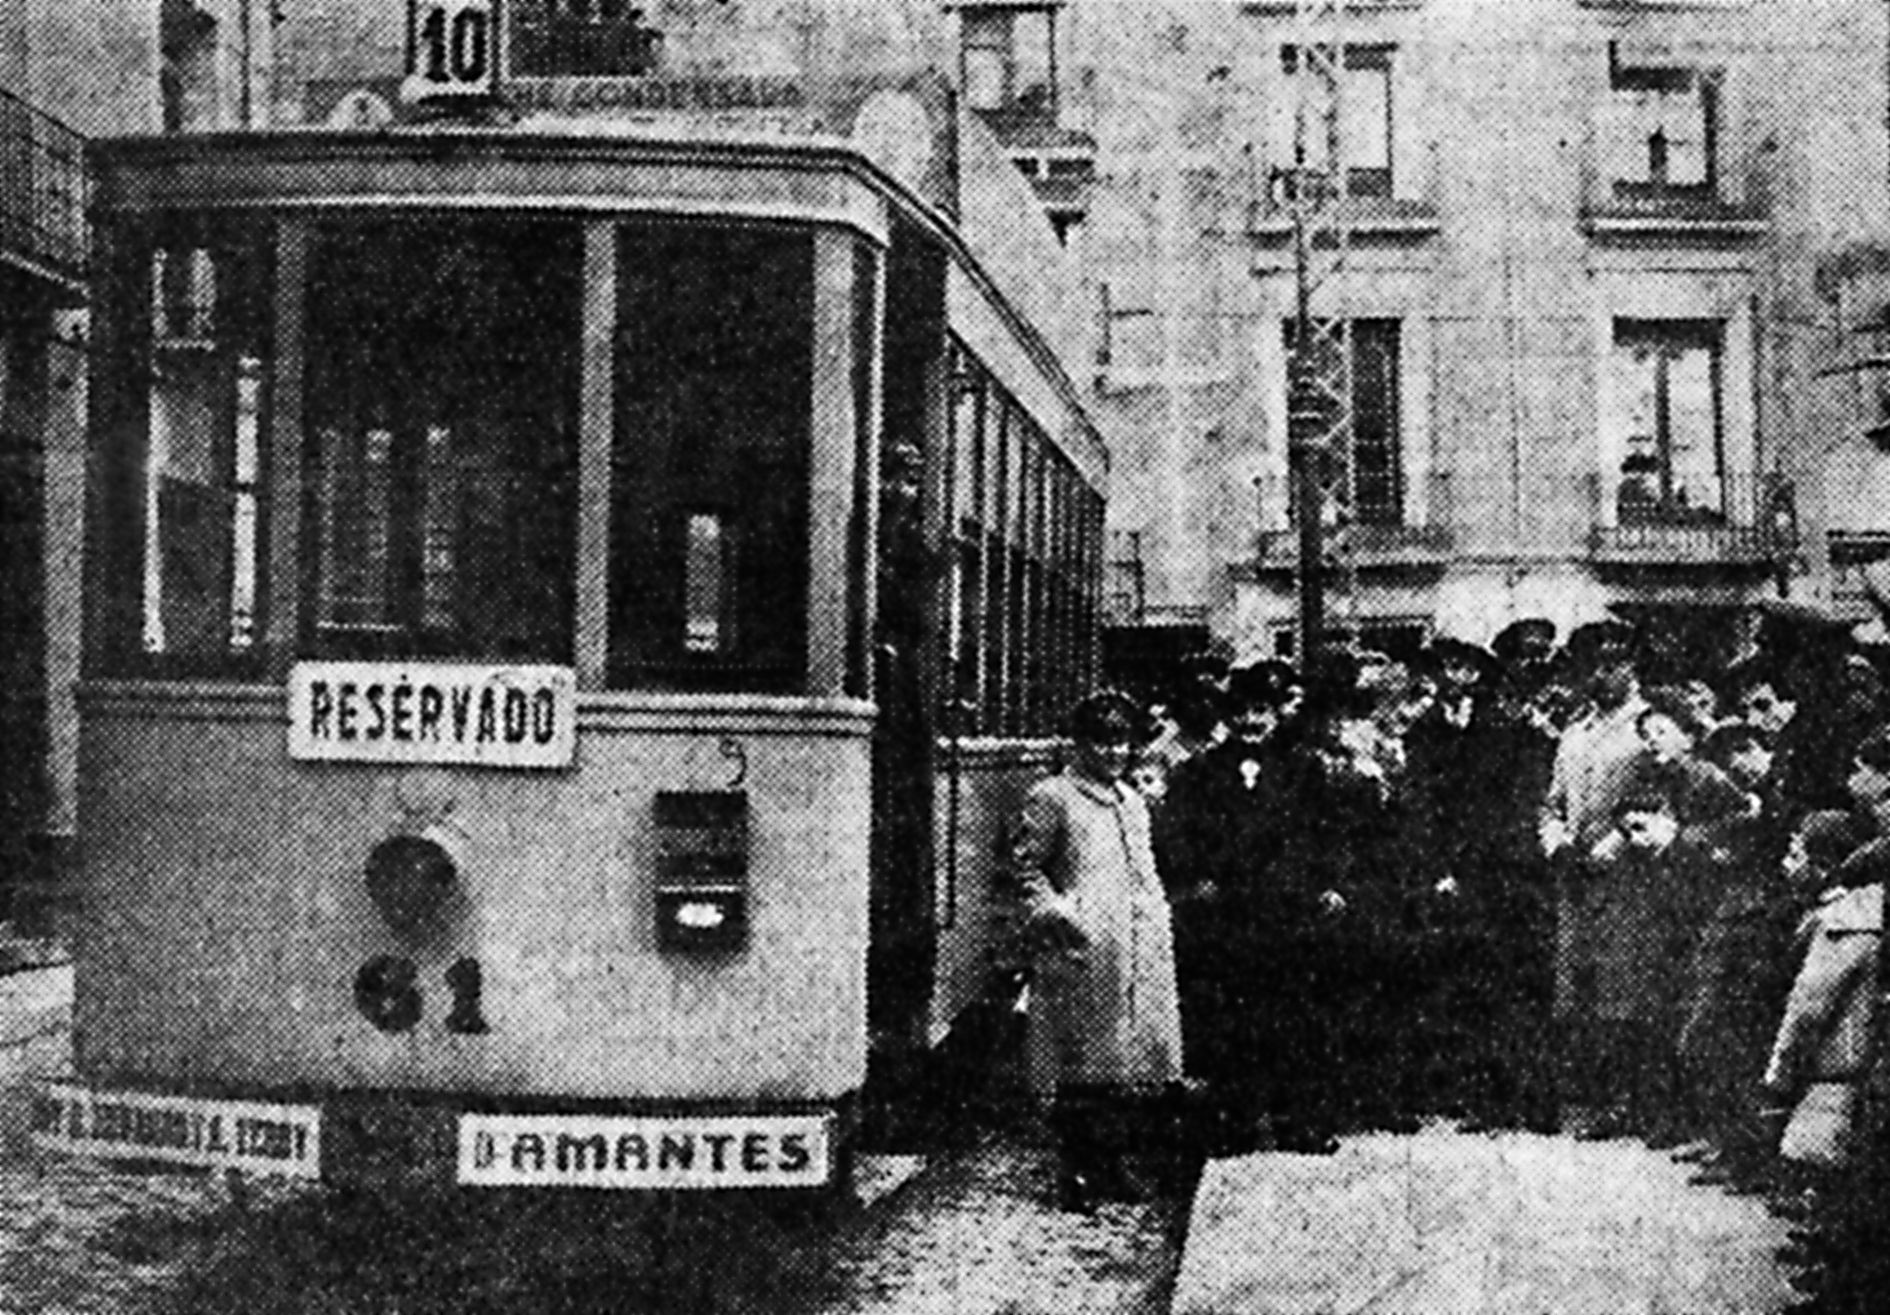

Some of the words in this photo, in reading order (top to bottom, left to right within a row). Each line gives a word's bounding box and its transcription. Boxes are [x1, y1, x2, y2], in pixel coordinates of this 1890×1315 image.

[421, 7, 488, 84] 10
[310, 681, 555, 744] RESERVADO
[353, 955, 492, 1036] 61
